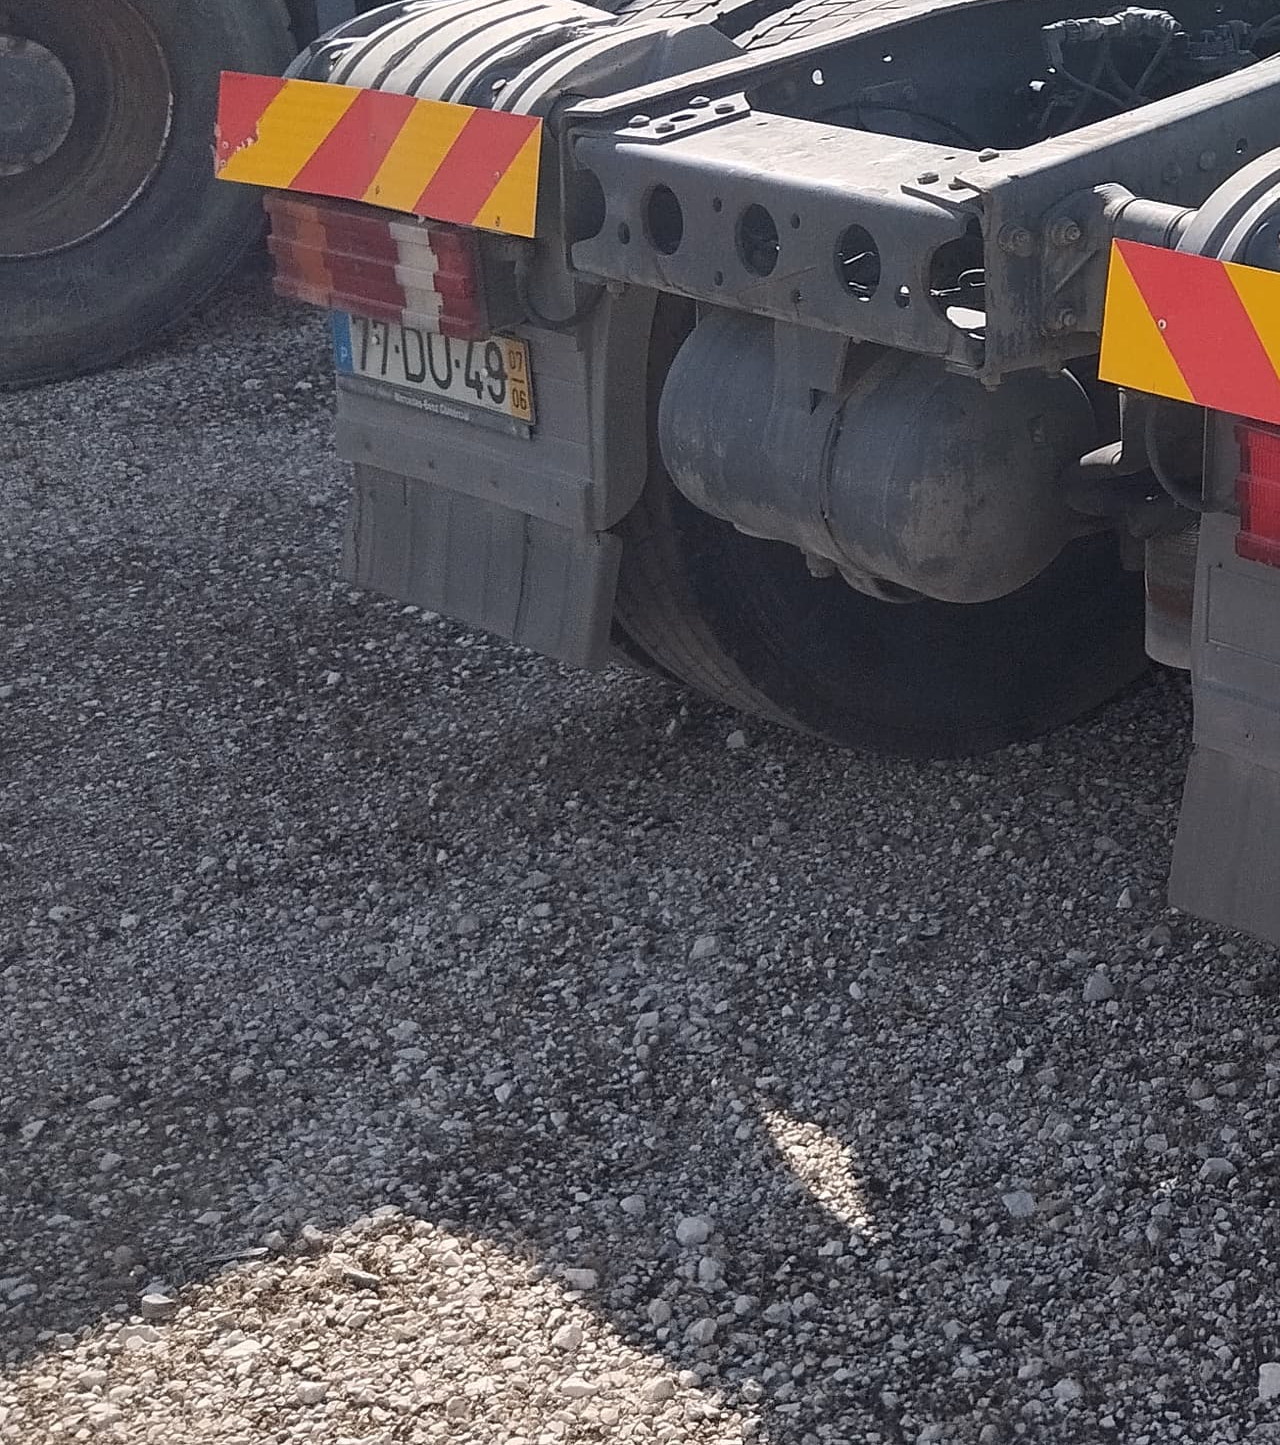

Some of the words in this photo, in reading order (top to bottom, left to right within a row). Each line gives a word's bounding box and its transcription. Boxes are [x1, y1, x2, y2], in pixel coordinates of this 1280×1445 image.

[351, 316, 507, 405] 77-DU-49
[508, 349, 523, 373] 07
[511, 387, 528, 411] 06
